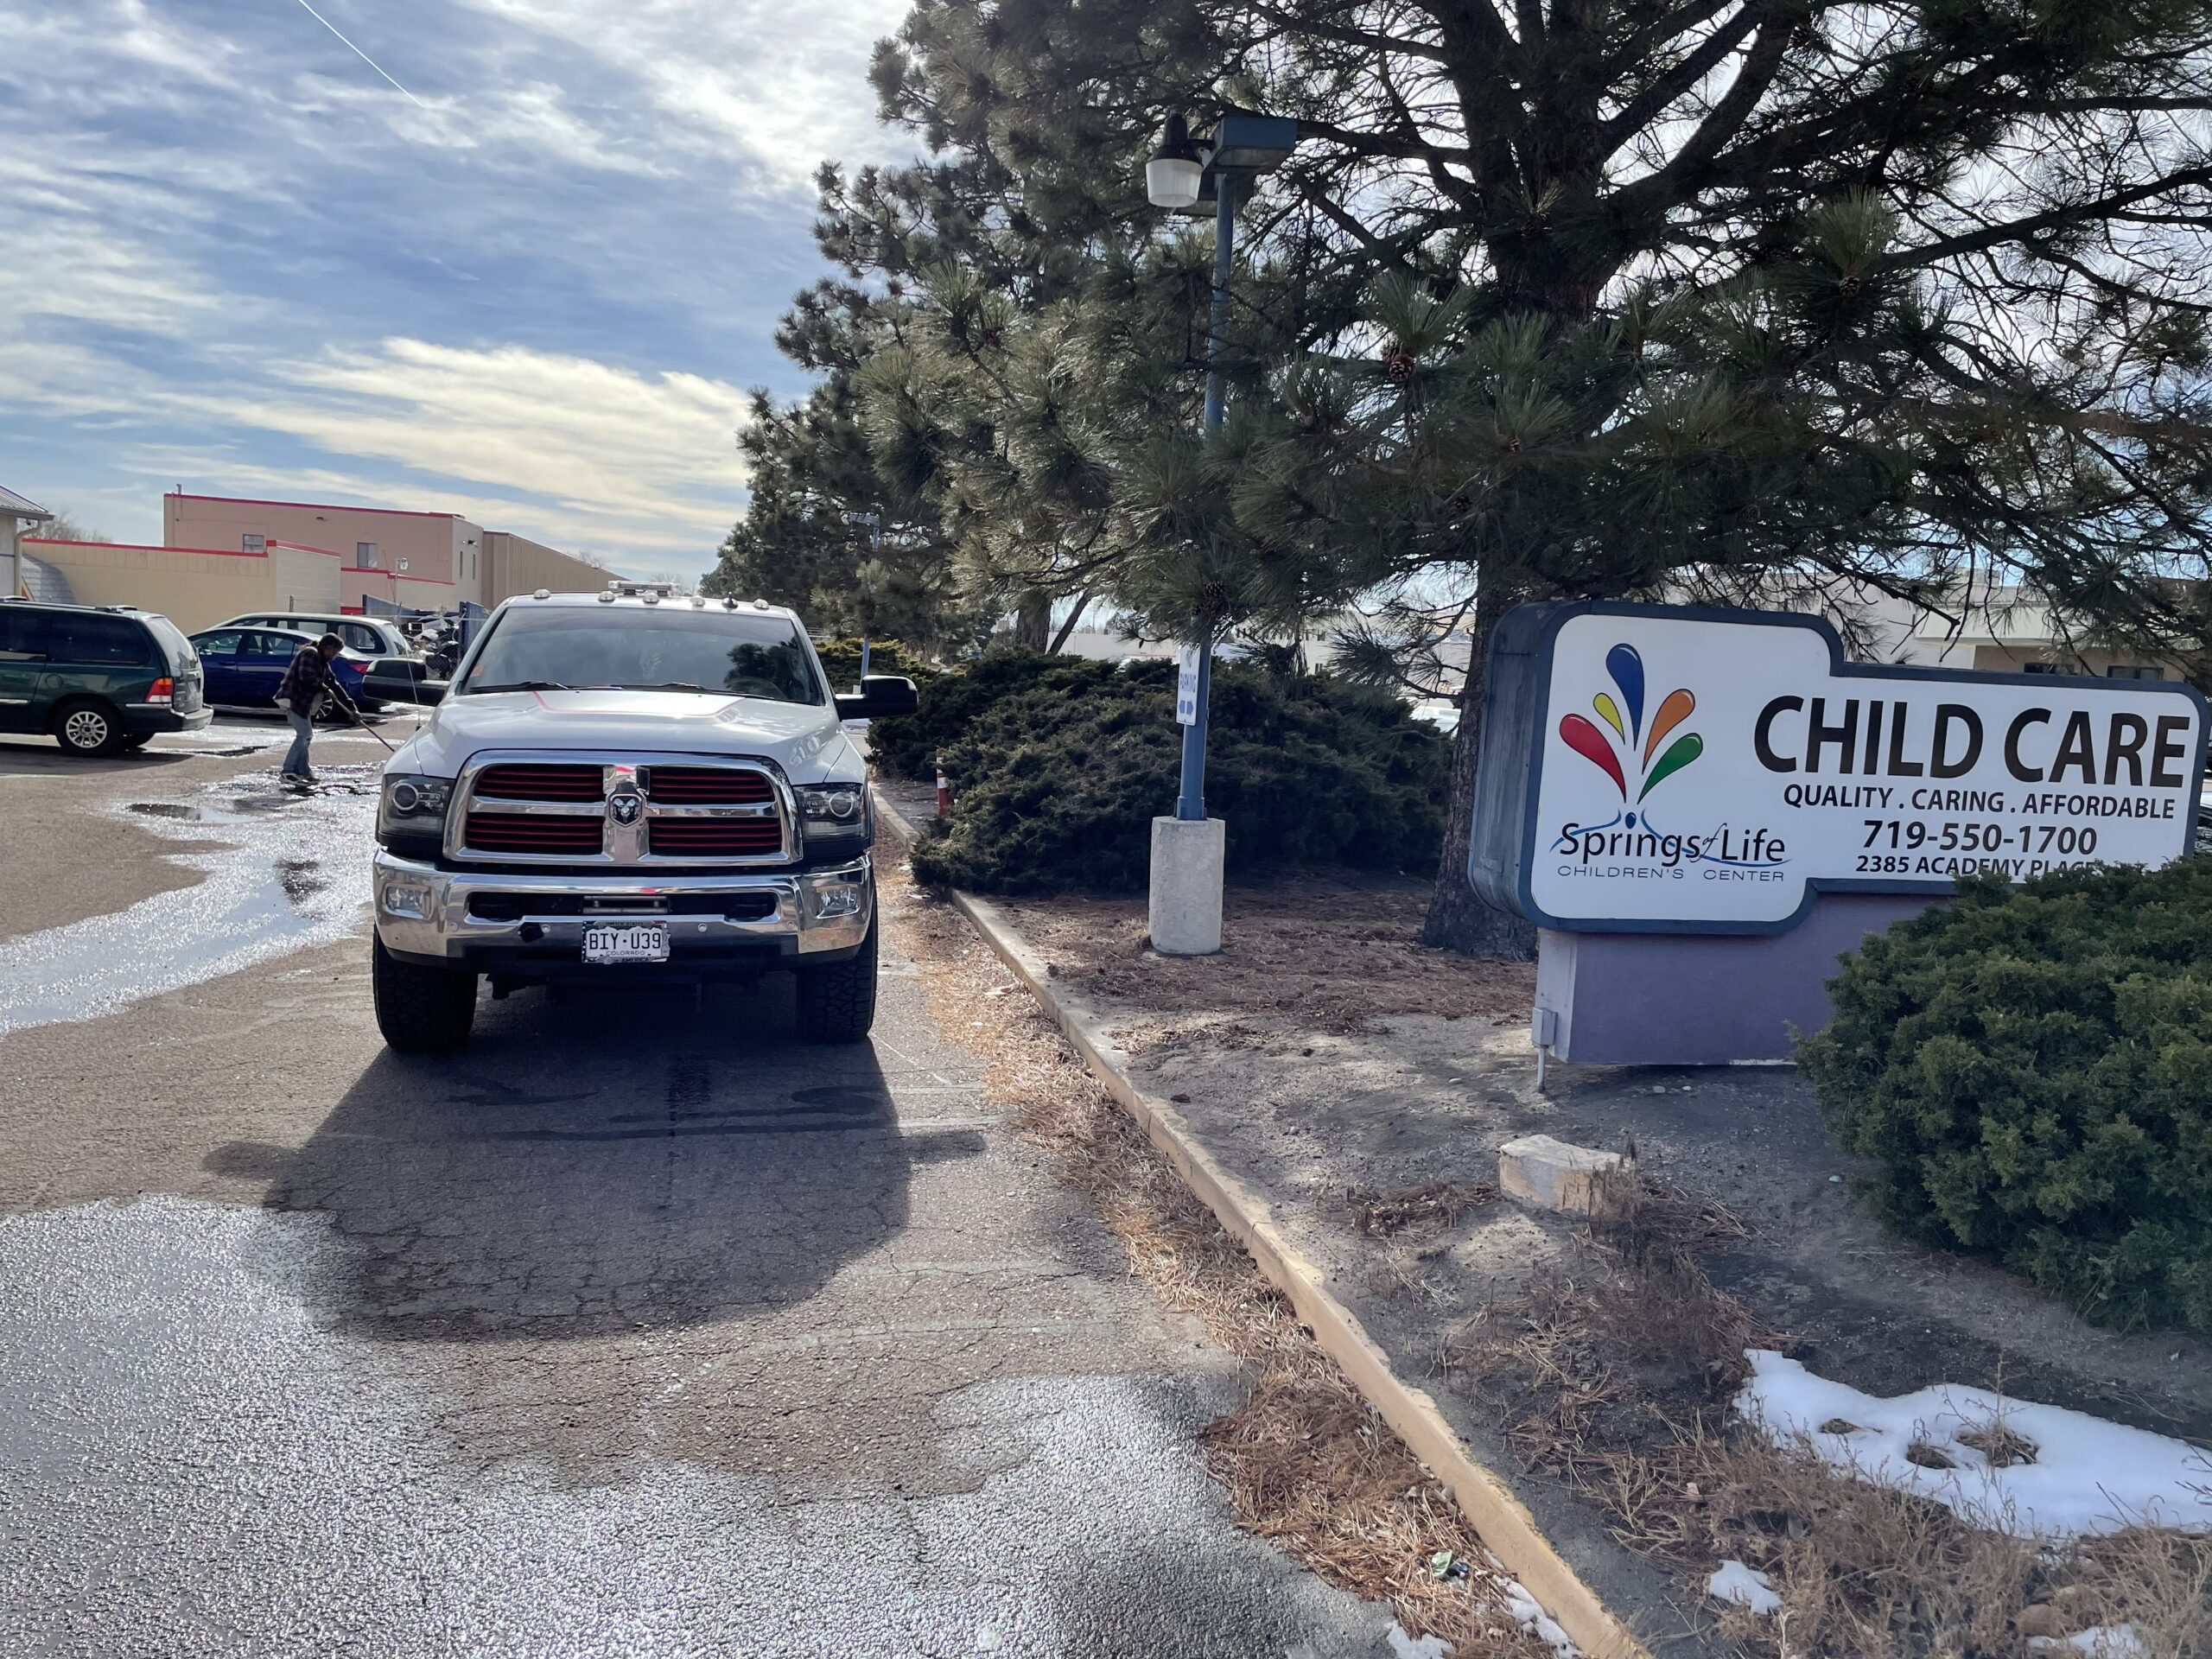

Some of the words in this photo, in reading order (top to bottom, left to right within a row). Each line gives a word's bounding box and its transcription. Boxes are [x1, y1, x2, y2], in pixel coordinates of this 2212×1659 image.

[1754, 695, 1984, 779] CHILD
[2004, 707, 2191, 788] CARE
[1783, 783, 1894, 809] QUALITY
[1911, 788, 2005, 812] CARING
[2022, 793, 2176, 819] AFFORDABLE
[1559, 823, 1700, 867] Springs
[1689, 823, 1728, 863] of
[1720, 828, 1786, 862] Life
[1863, 819, 2098, 855] 719-550-1700
[1556, 866, 1685, 880] CHILDREN'S
[1702, 869, 1785, 882] CENTER
[1855, 855, 1910, 874] 2385
[1915, 855, 2025, 877] ACADEMY
[2031, 860, 2095, 877] PLA
